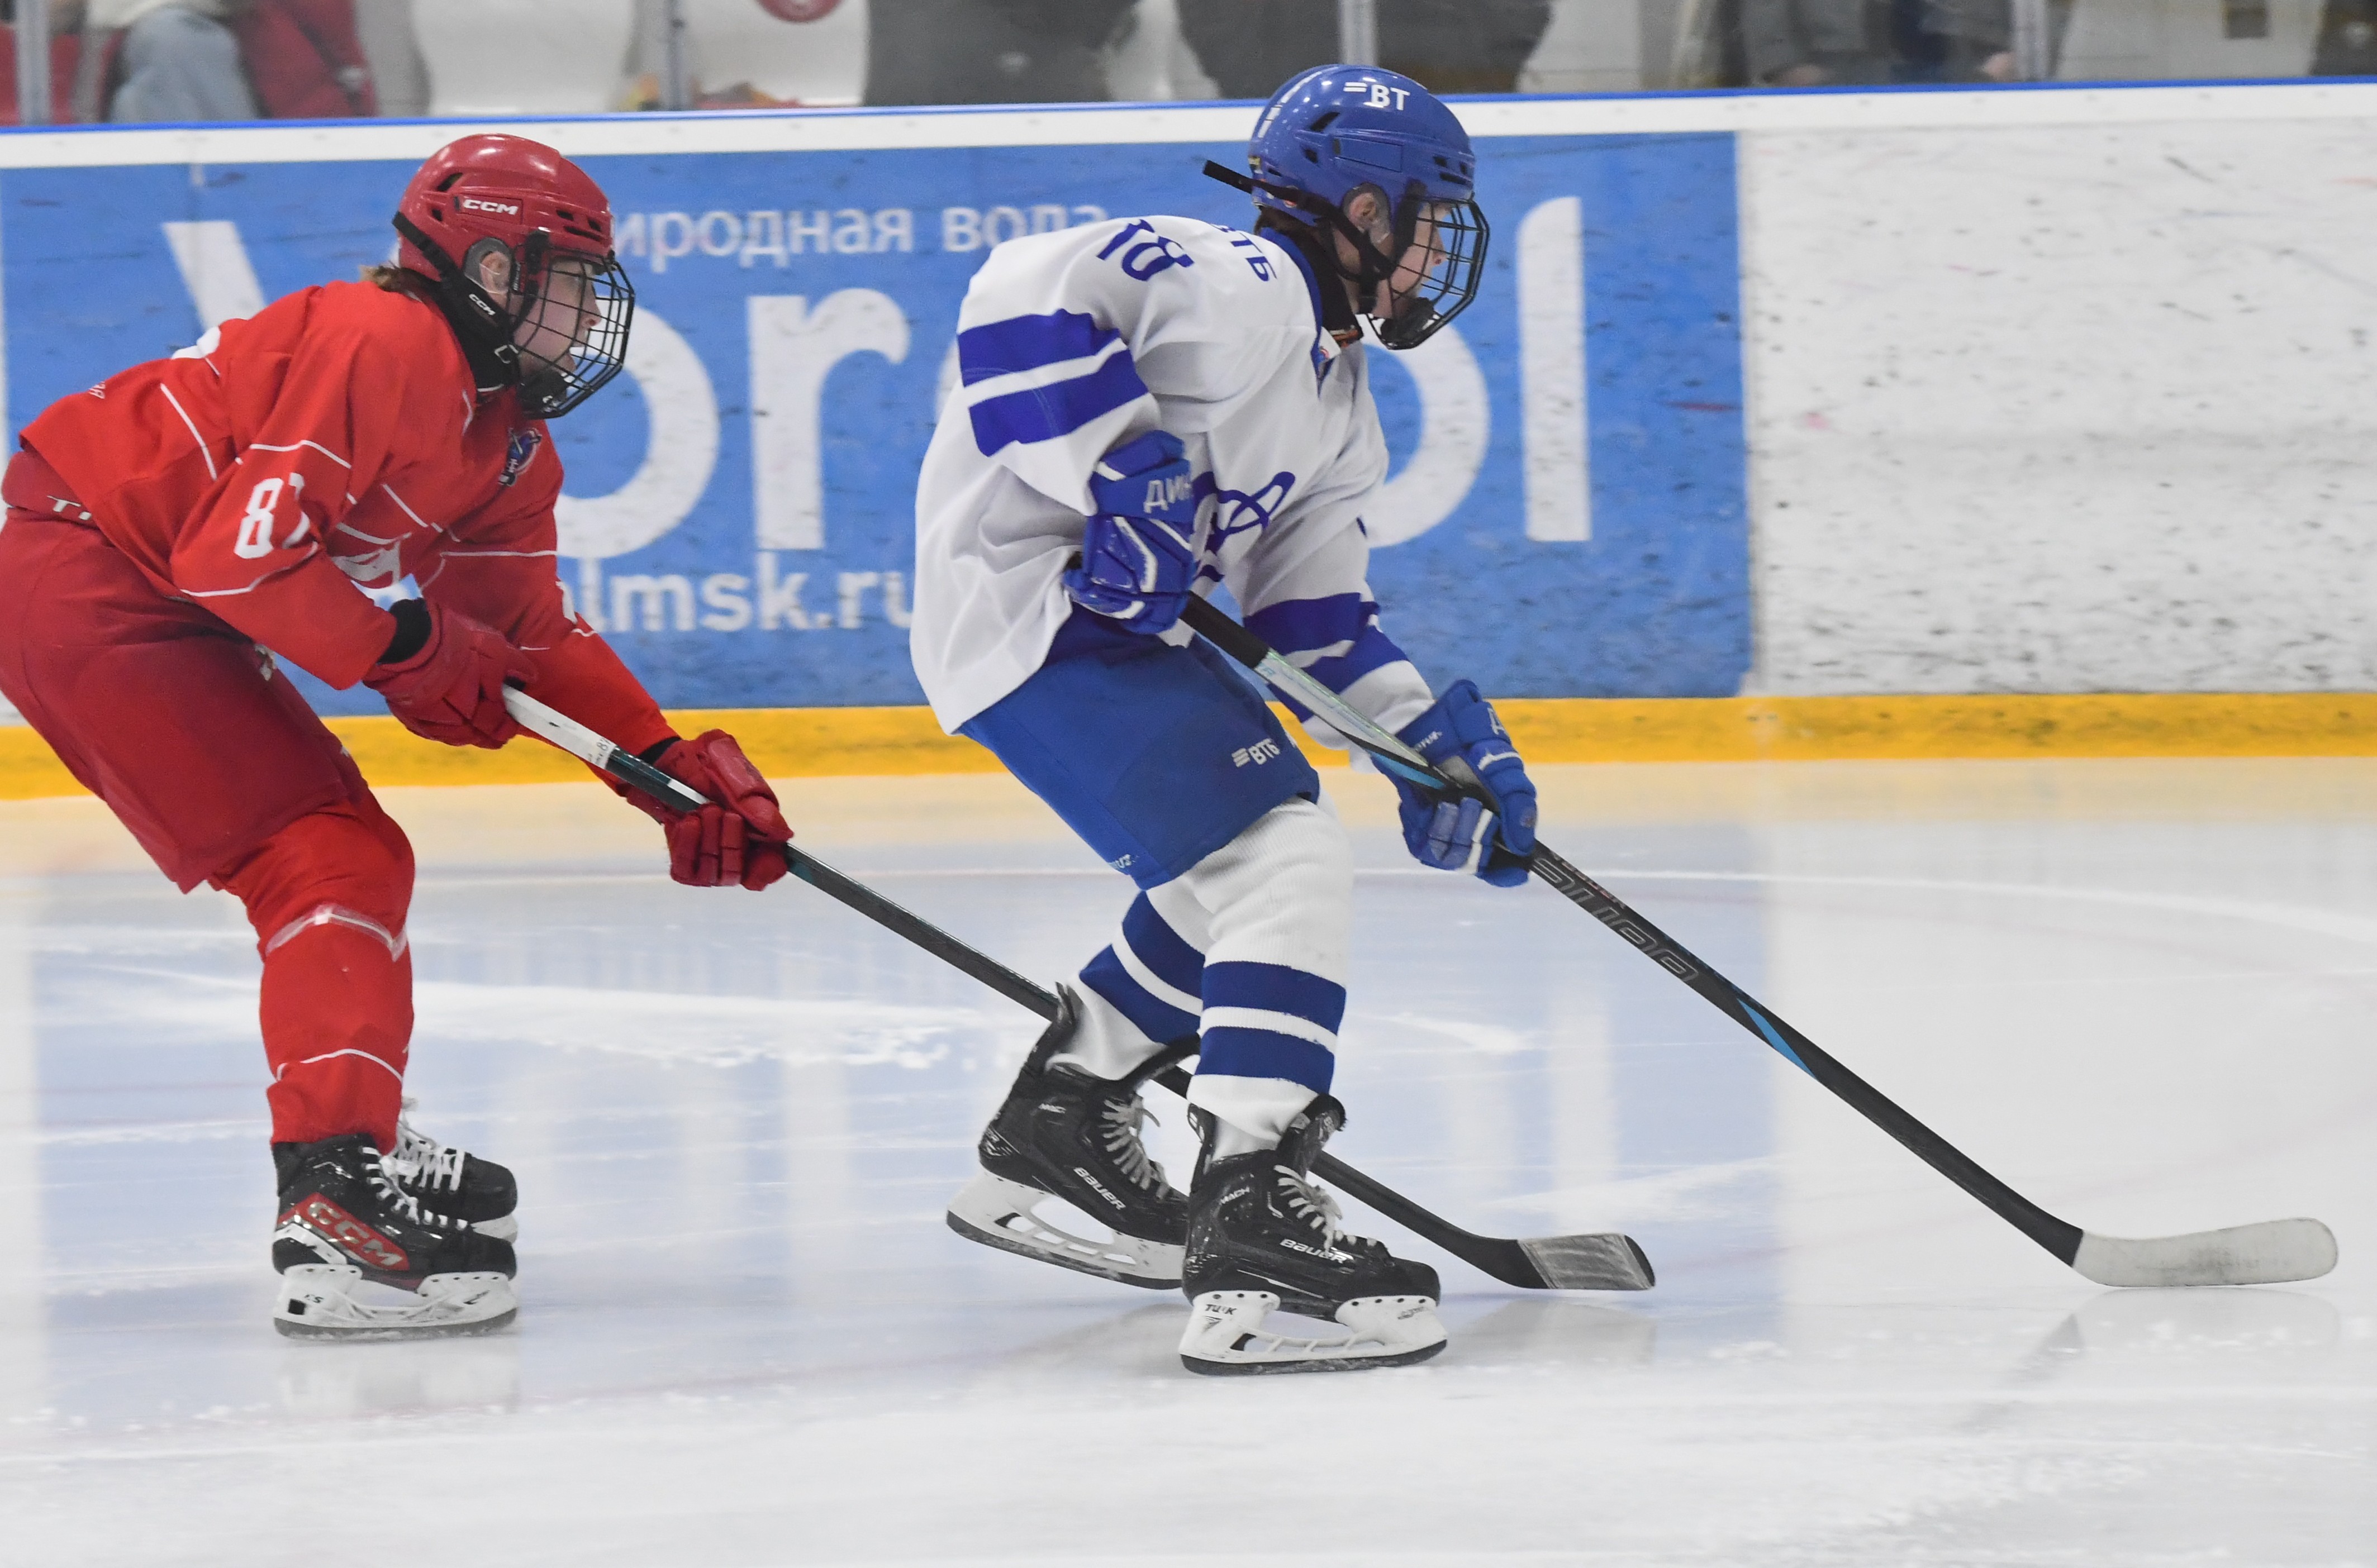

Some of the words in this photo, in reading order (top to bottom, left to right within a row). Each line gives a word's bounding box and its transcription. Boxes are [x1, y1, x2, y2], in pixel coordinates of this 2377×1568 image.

[463, 199, 519, 216] CCM
[1096, 219, 1195, 282] 18
[469, 293, 496, 316] CCM
[1248, 738, 1281, 765] ВТБ
[307, 1201, 402, 1266] CCM
